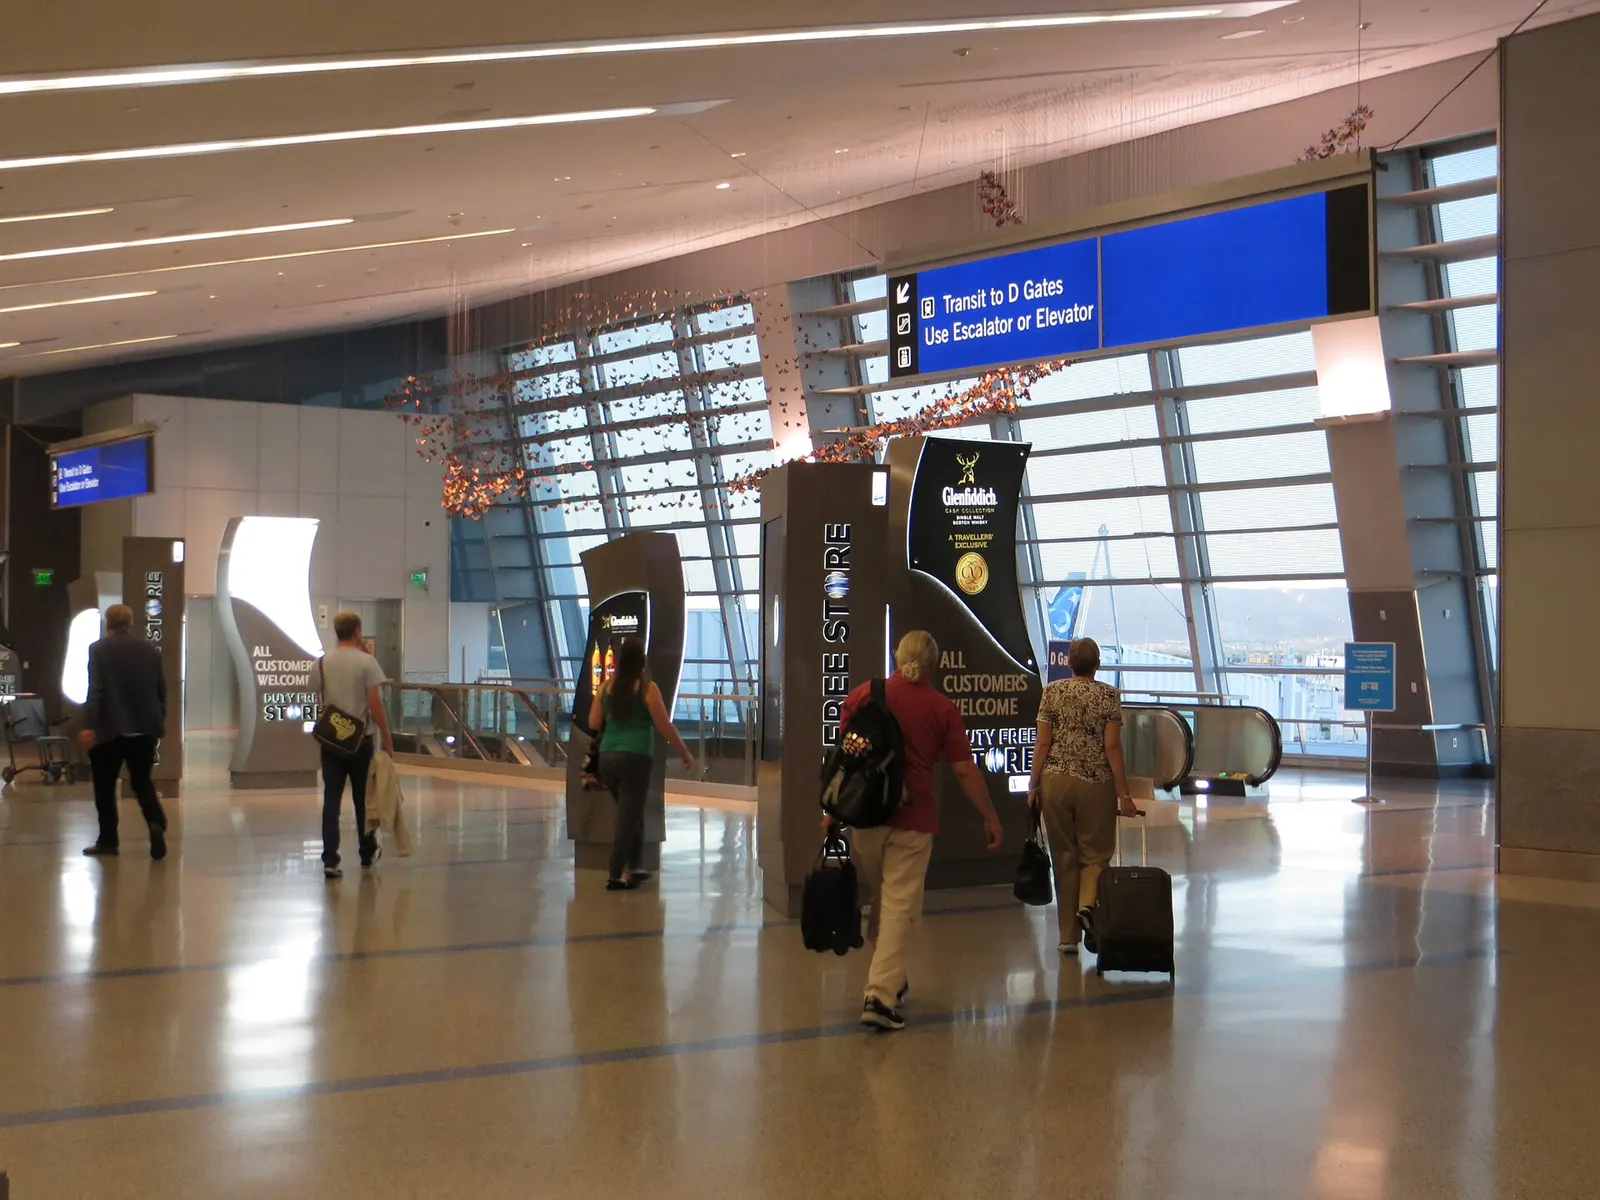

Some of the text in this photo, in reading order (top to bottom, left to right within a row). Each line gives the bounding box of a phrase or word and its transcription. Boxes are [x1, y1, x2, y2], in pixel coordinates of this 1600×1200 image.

[943, 277, 1064, 314] Transit to D Gates
[925, 303, 1094, 346] Use Escalator or Elevator
[942, 486, 998, 506] Glenfiddich
[954, 541, 988, 549] EXCLUSIVE
[253, 645, 272, 657] ALL
[940, 650, 967, 669] ALL
[1050, 652, 1056, 665] D
[255, 660, 316, 672] CUSTOMER
[943, 674, 1028, 693] CUSTOMERS
[264, 692, 317, 704] DUTY FRE
[965, 727, 1037, 746] UTY FREE
[971, 746, 1034, 774] TORE
